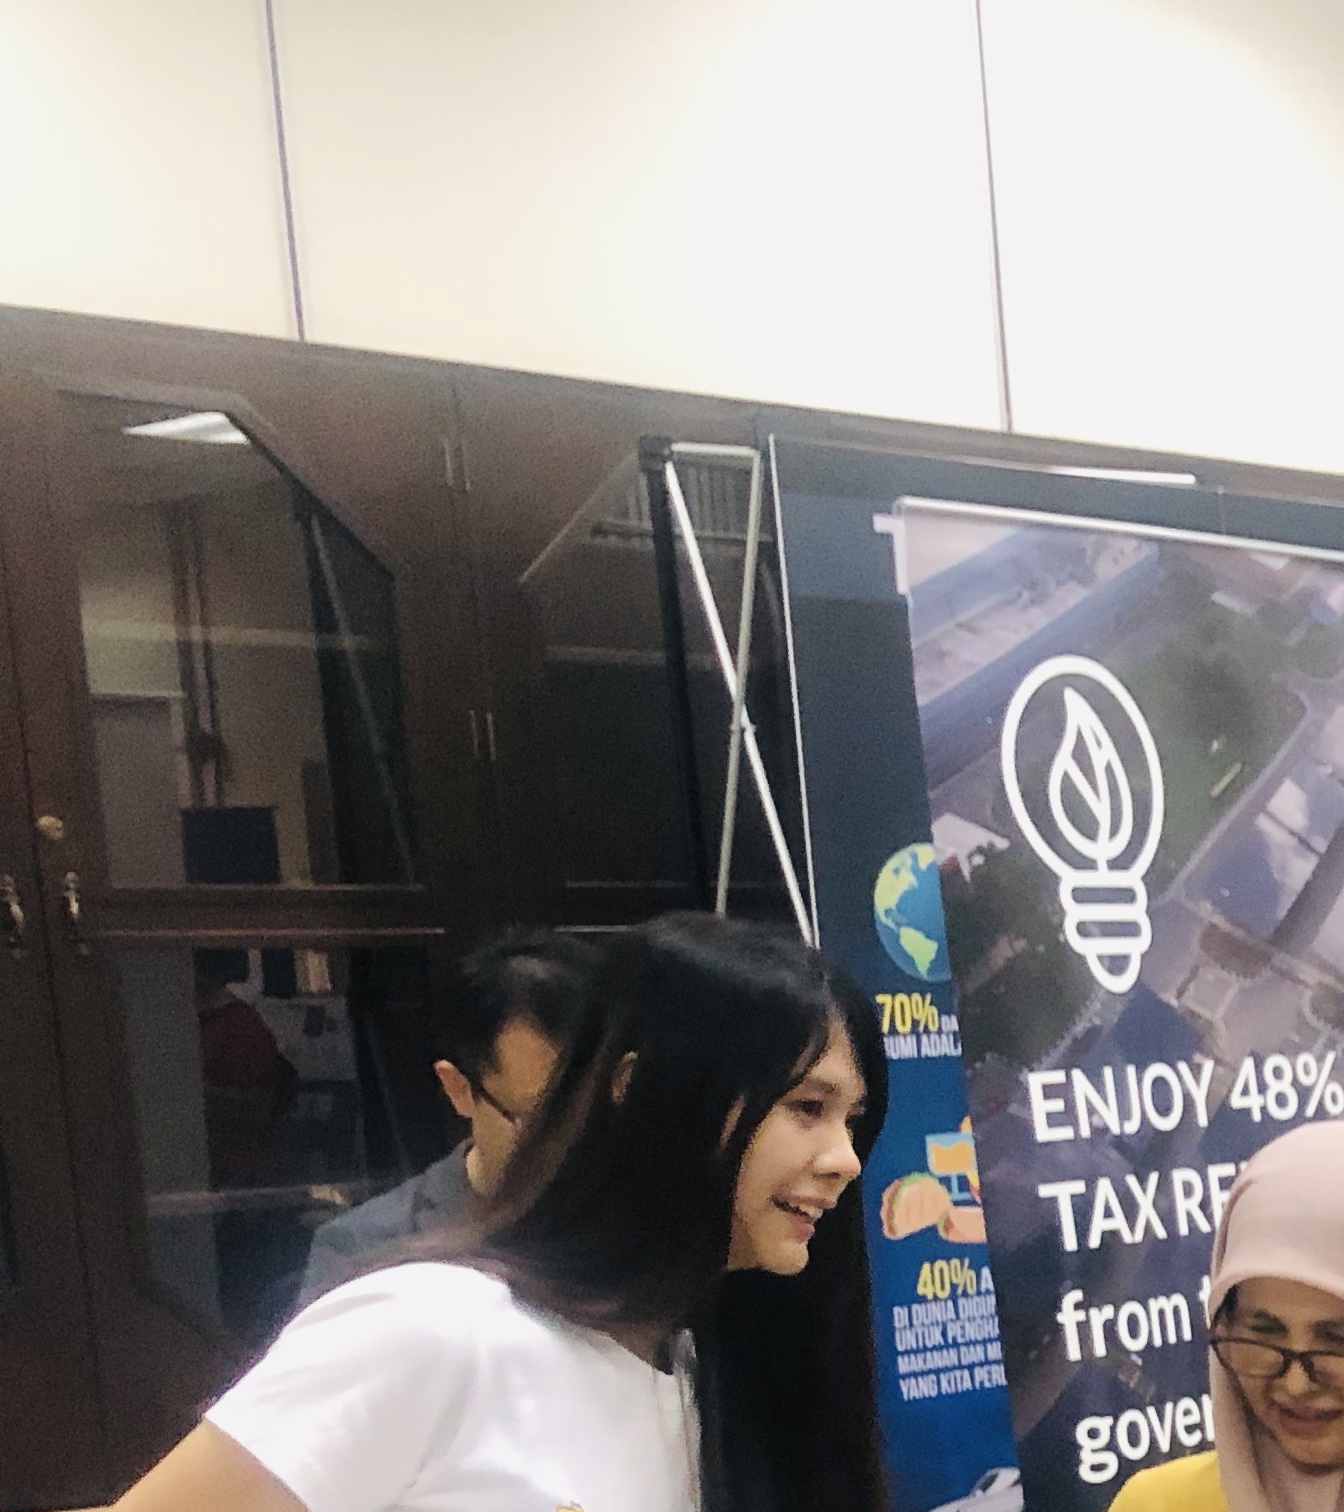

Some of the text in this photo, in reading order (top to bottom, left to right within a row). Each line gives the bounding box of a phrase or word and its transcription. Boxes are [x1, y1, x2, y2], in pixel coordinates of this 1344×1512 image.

[874, 993, 939, 1034] 70%
[1026, 1058, 1216, 1144] ENJOY
[1038, 1173, 1168, 1252] TAX
[916, 1258, 977, 1301] 40%
[911, 1300, 956, 1328] DUNIA
[1056, 1290, 1193, 1362] from
[895, 1325, 944, 1352] UNTUK
[899, 1373, 939, 1402] YANG
[939, 1368, 974, 1394] KITA
